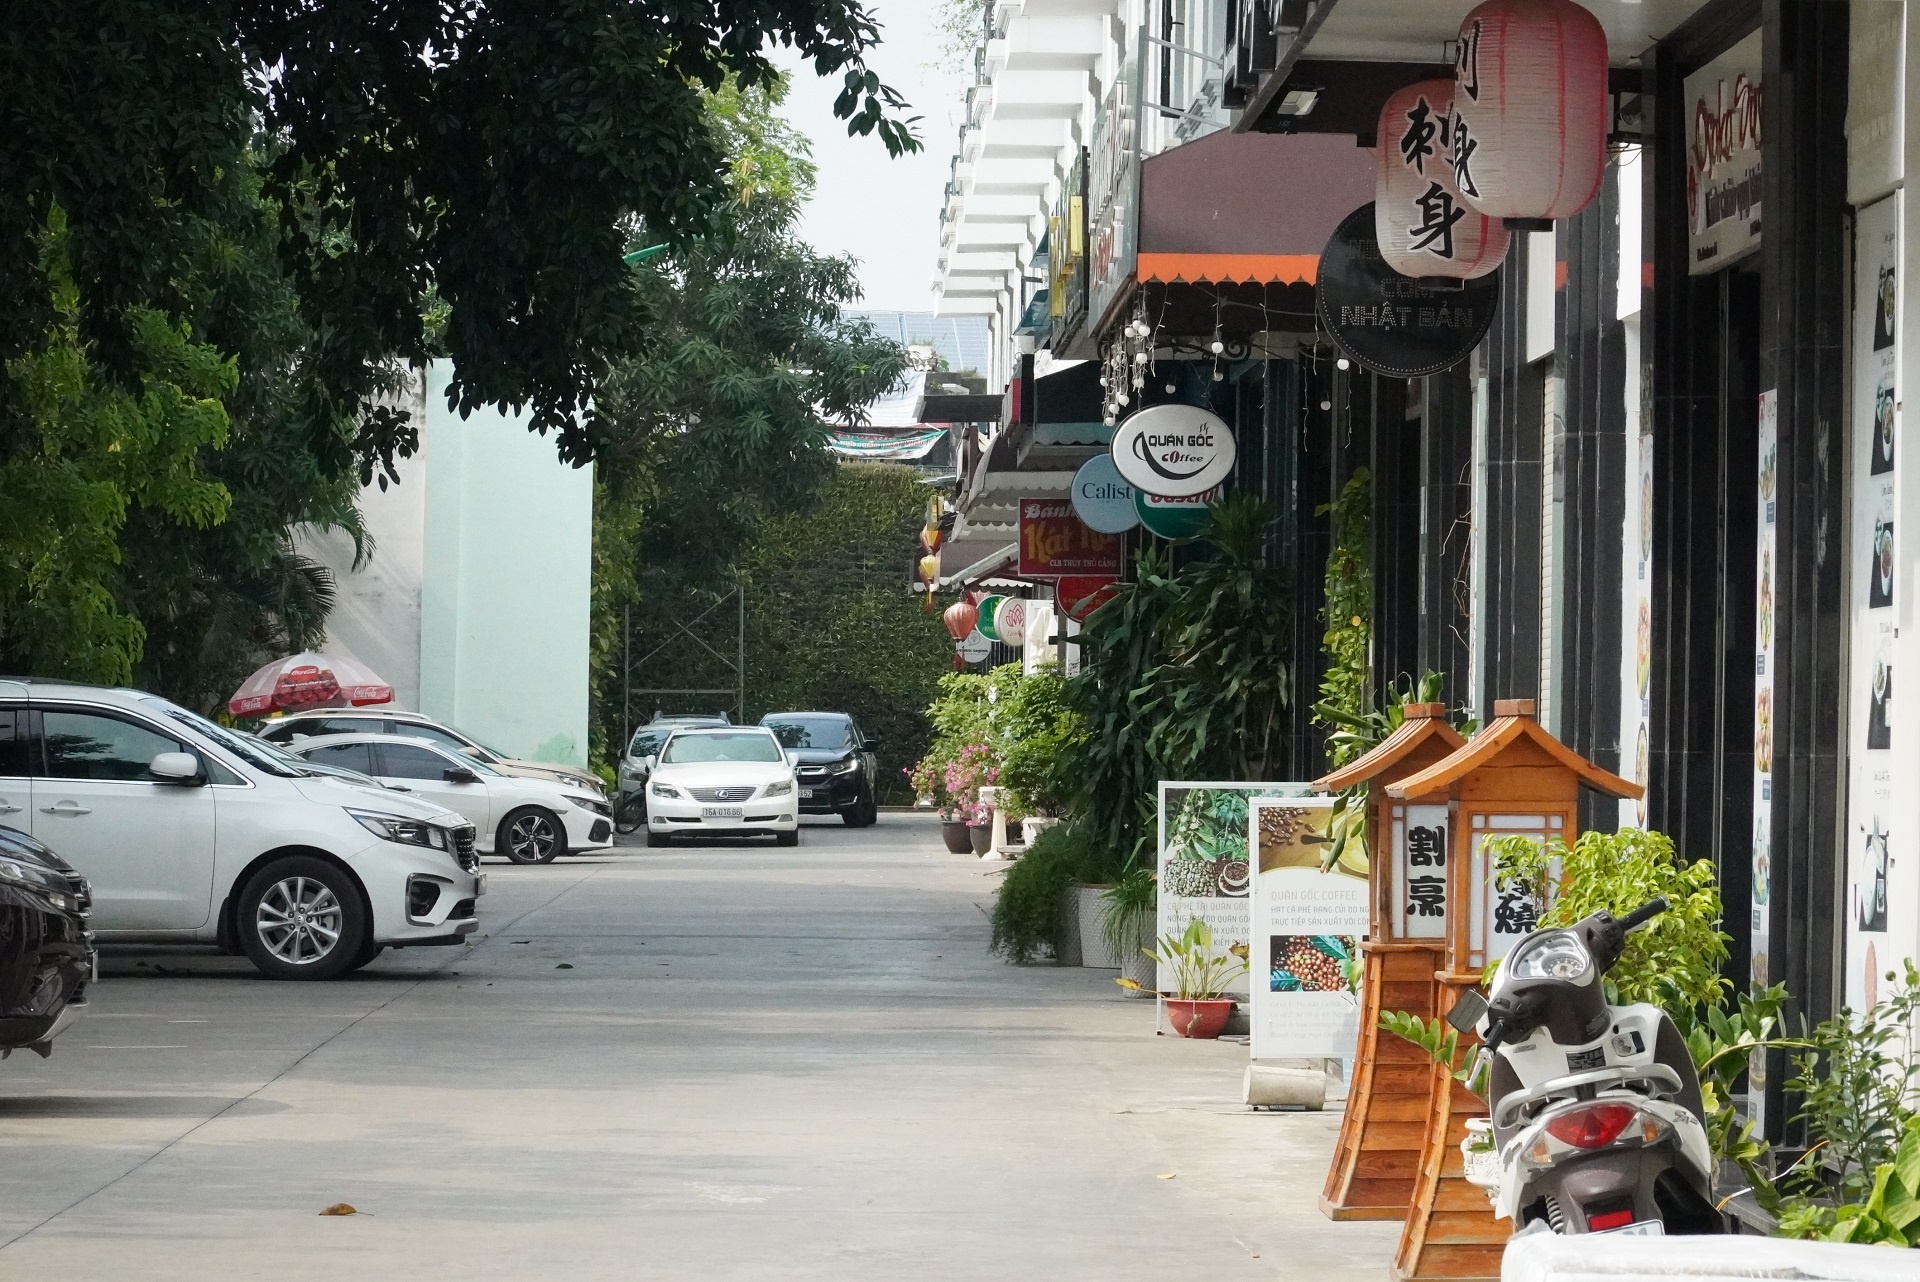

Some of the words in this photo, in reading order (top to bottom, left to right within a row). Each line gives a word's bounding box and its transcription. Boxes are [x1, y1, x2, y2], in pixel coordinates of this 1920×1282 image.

[1148, 433, 1184, 448] QUÁN
[1407, 825, 1446, 917] 割烹
[1322, 891, 1356, 901] COFFEE
[1239, 913, 1250, 922] GỐ
